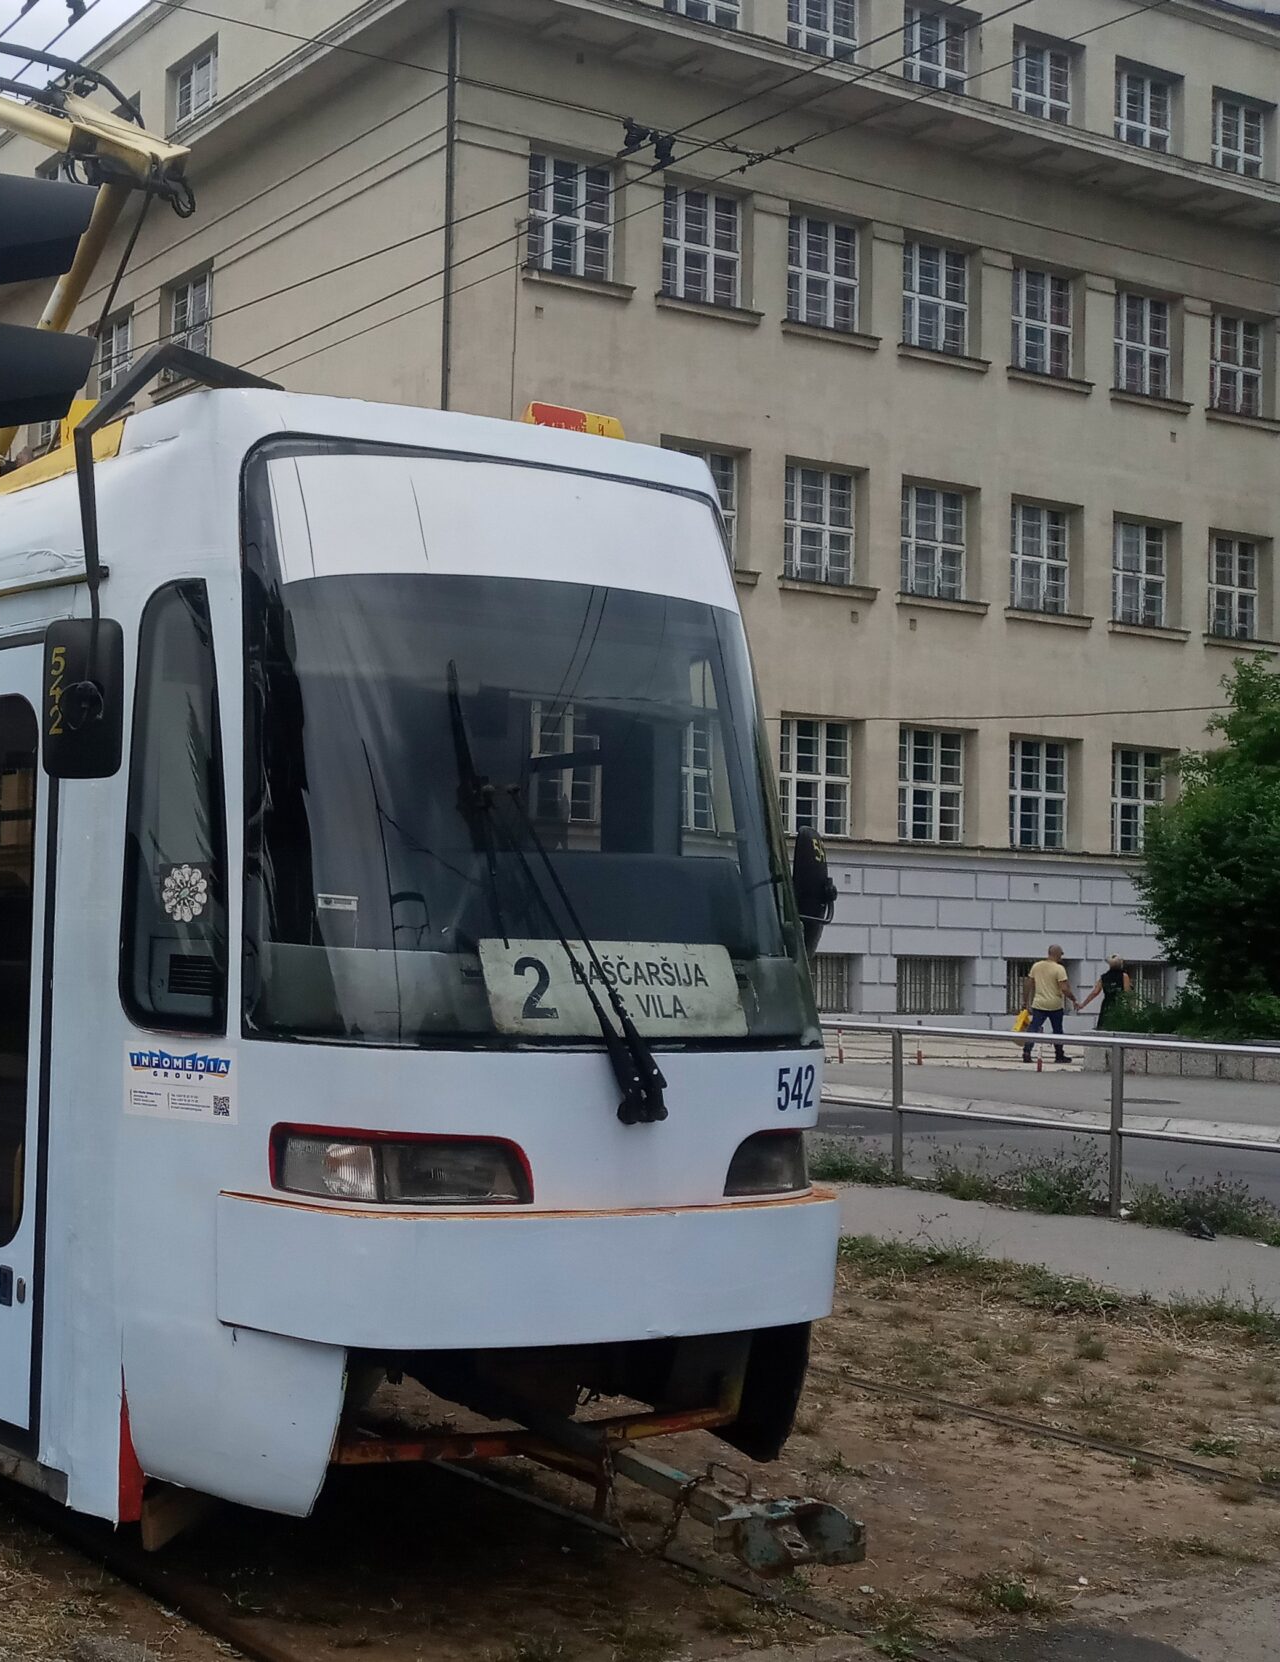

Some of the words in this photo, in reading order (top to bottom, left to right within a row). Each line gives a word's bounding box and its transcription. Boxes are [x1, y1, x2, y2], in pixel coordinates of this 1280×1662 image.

[49, 646, 66, 735] 542
[514, 957, 559, 1019] 2
[570, 954, 709, 988] BAŠČARŠIJA
[635, 993, 689, 1019] VILA
[132, 1055, 228, 1074] INFOMEDIA
[152, 1071, 204, 1081] GROUP
[777, 1064, 815, 1111] 542
